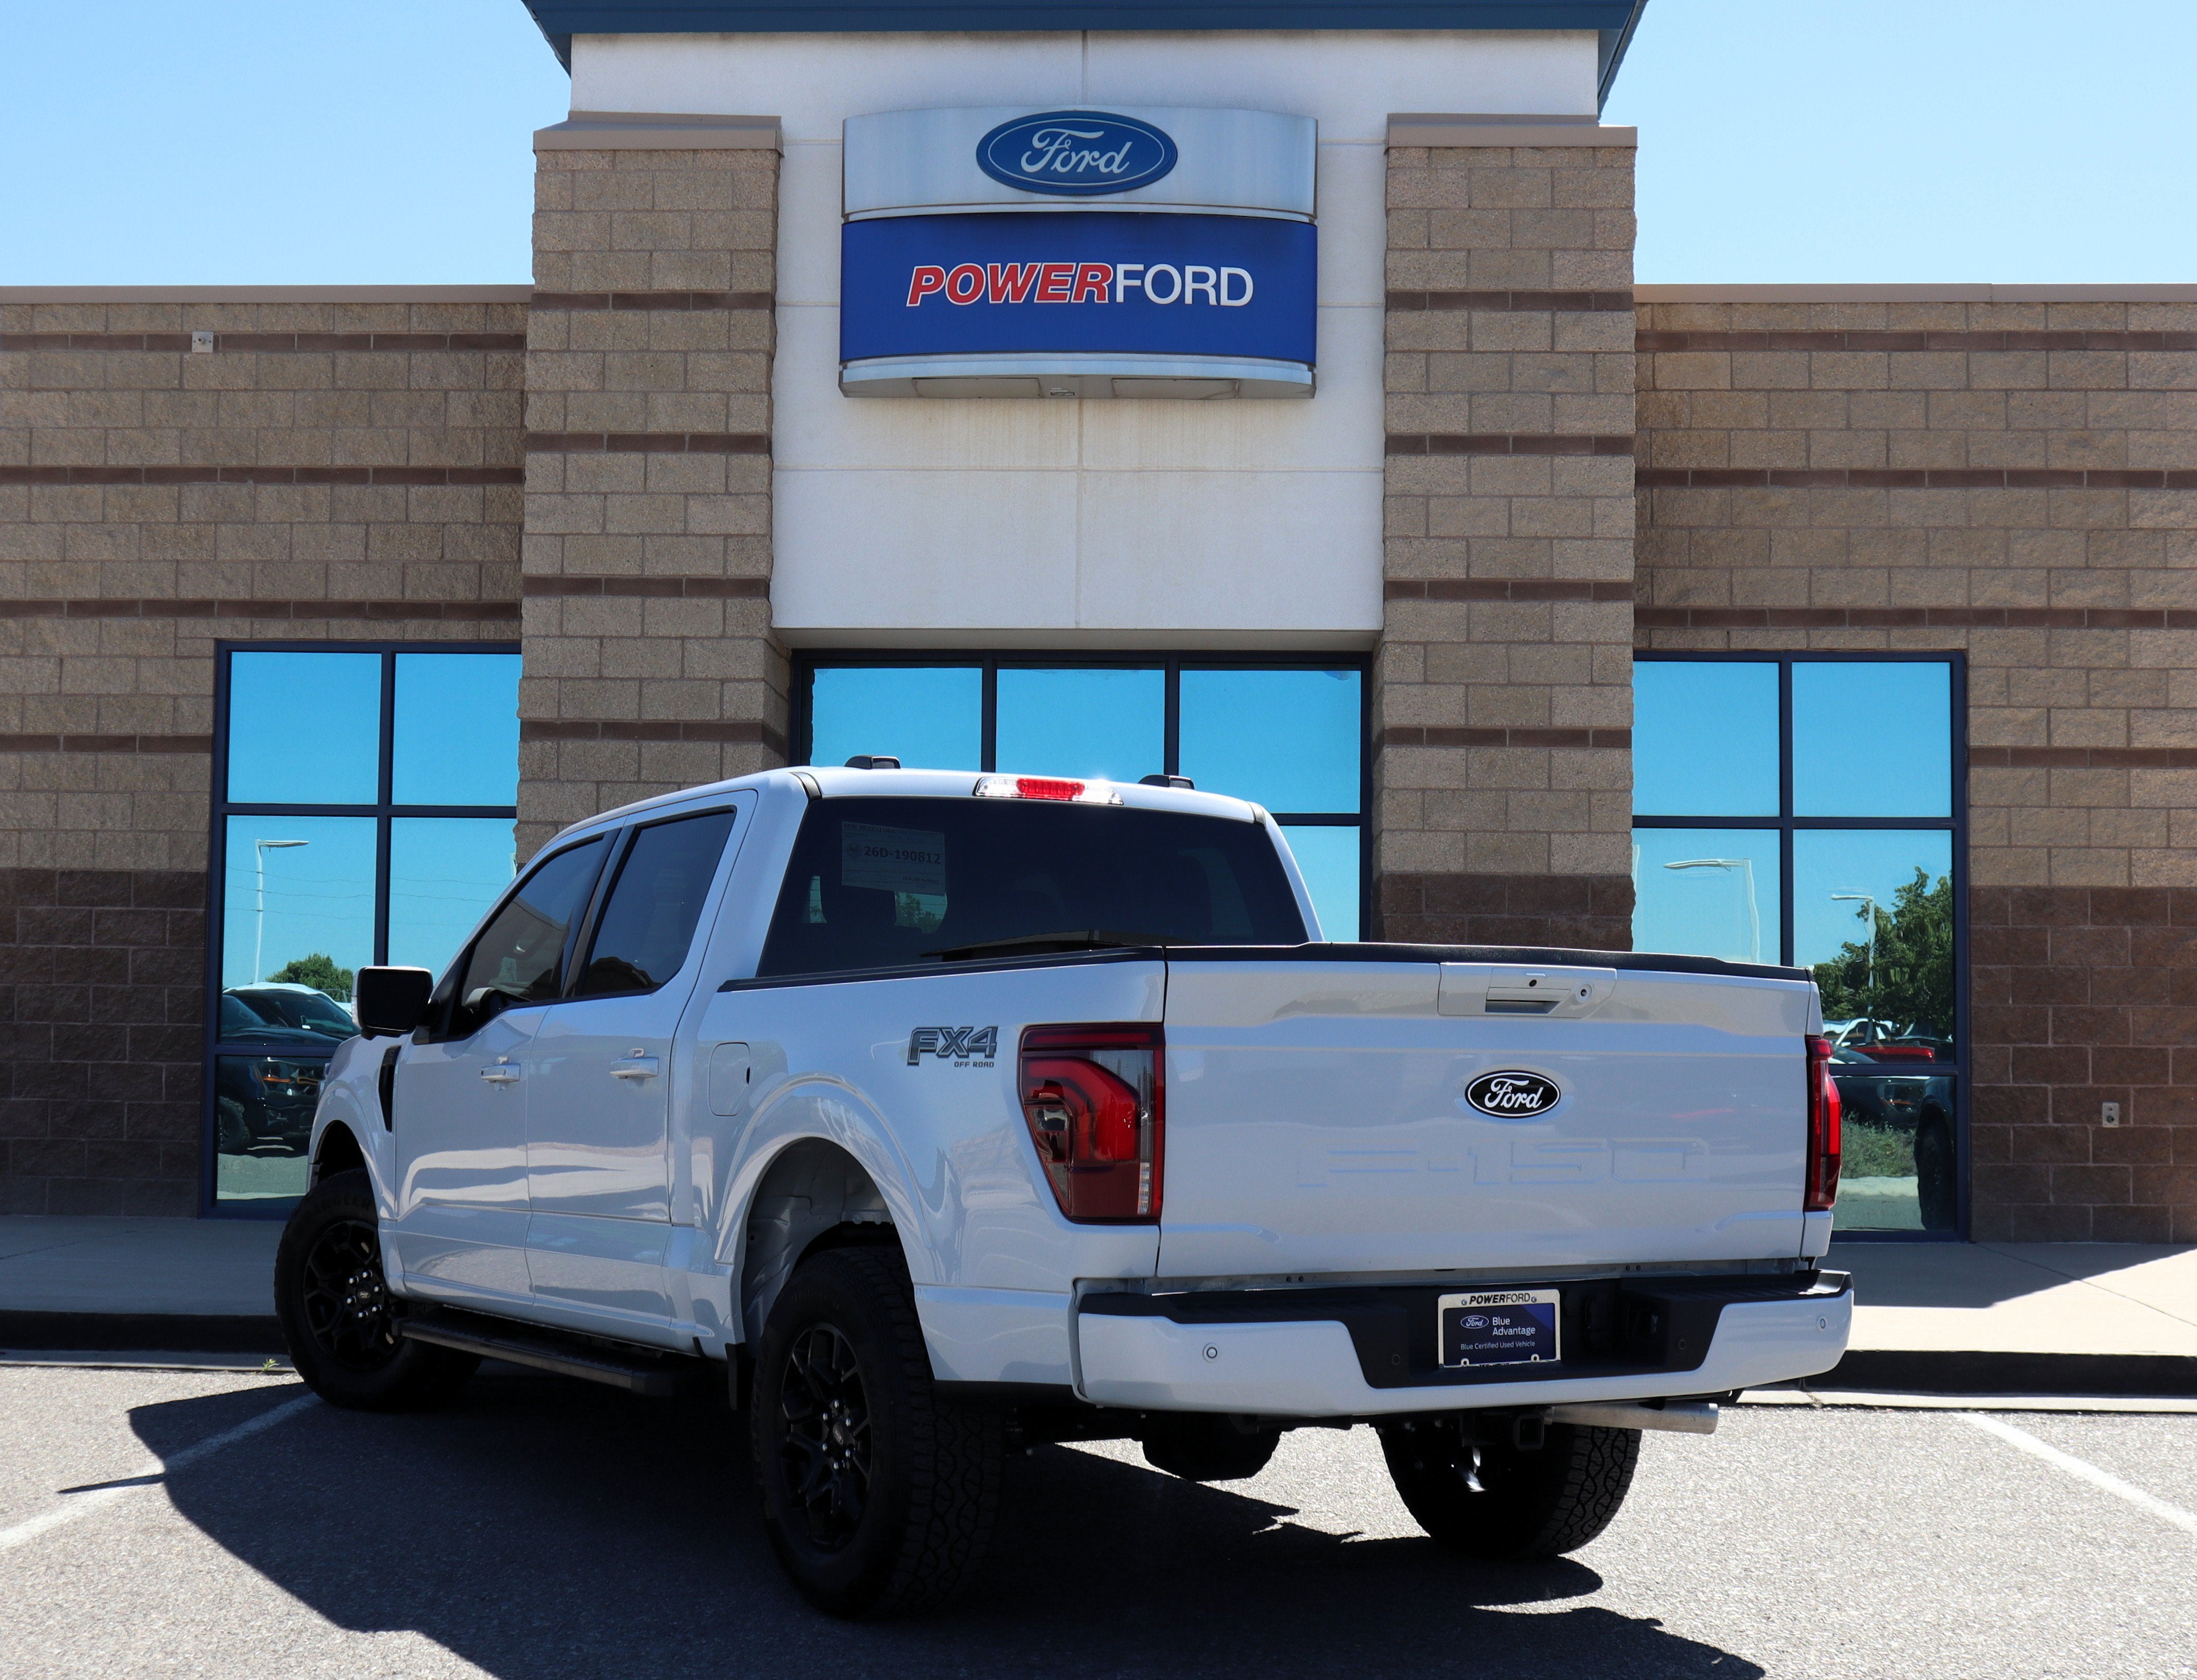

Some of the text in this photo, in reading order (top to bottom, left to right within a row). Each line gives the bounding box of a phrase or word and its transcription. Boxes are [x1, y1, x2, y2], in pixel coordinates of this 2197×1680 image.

[1021, 128, 1133, 173] Ford
[906, 262, 1254, 307] POWERFORD
[864, 845, 941, 864] 26D-190812
[907, 1026, 999, 1066] FX4
[1484, 1078, 1543, 1108] Ford
[1296, 1139, 1709, 1187] F-150
[1469, 1293, 1530, 1305] POWERFORD
[1466, 1317, 1483, 1327] Ford
[1492, 1316, 1510, 1326] Blue
[1492, 1326, 1536, 1336] Advantage
